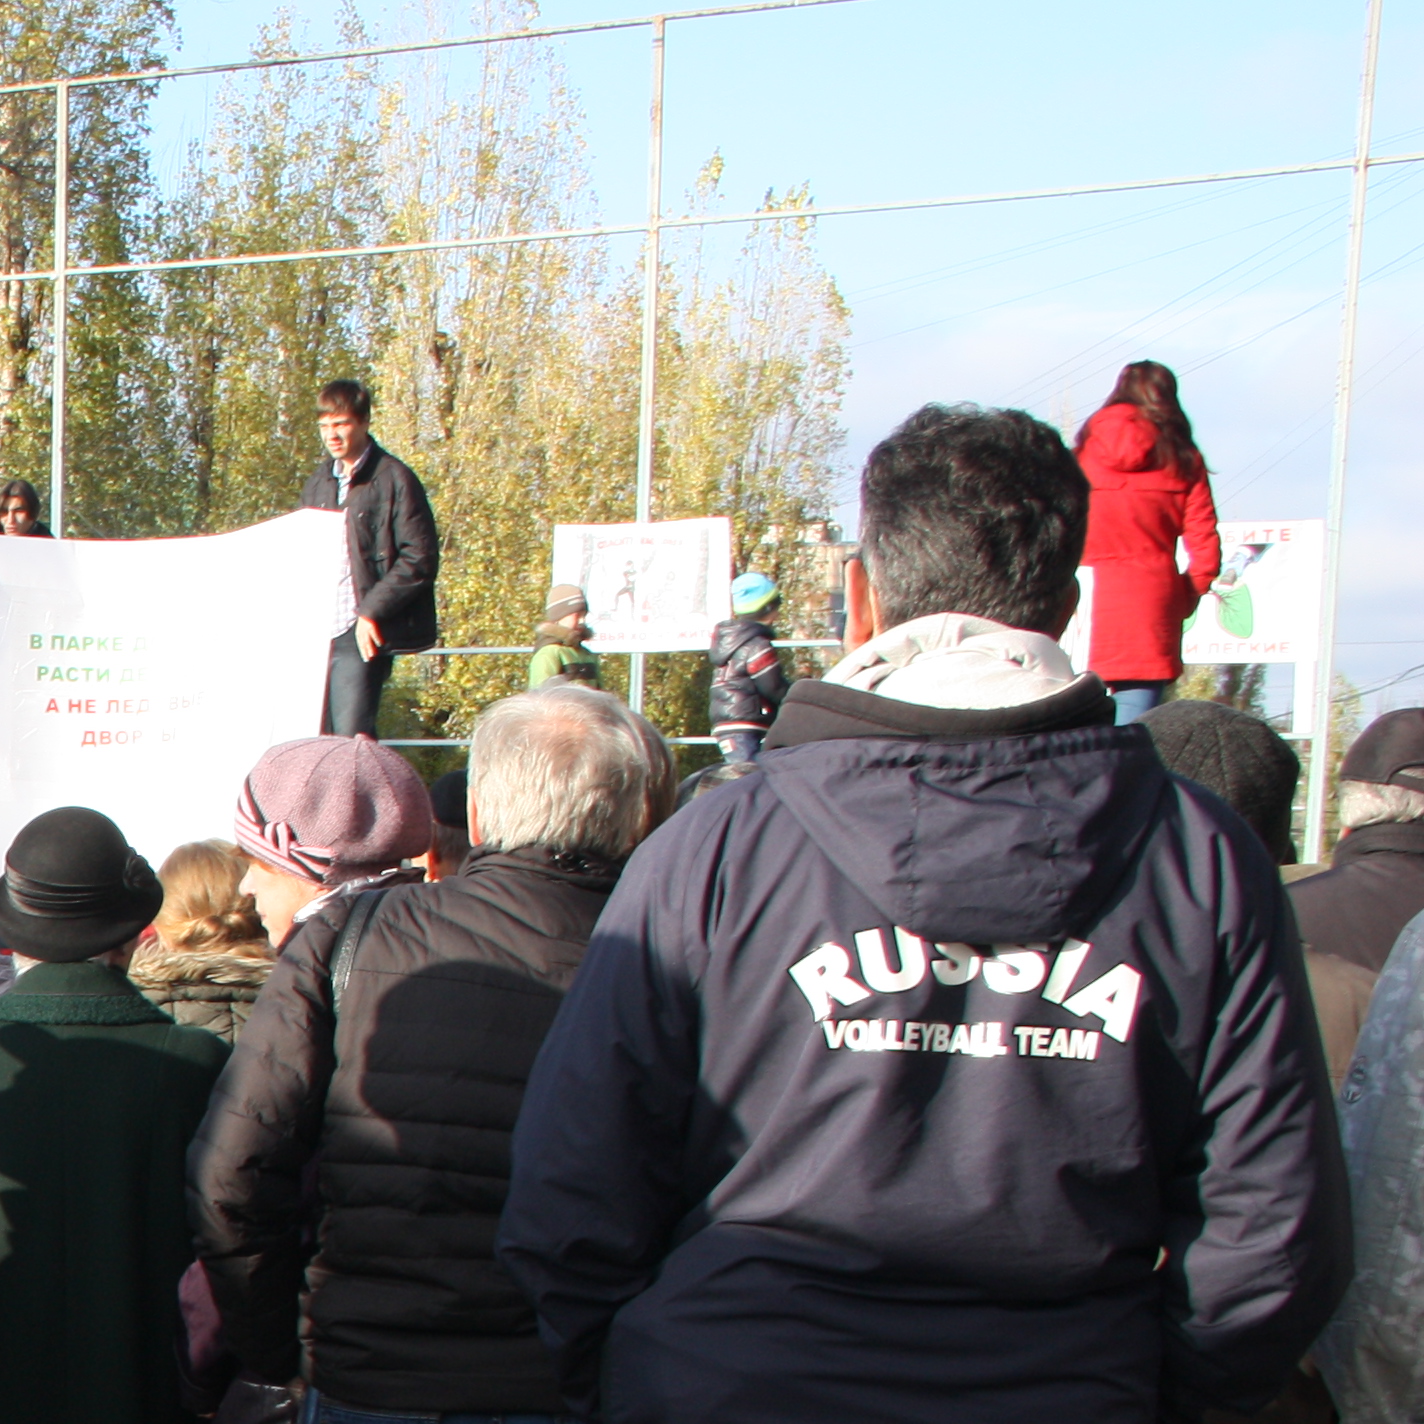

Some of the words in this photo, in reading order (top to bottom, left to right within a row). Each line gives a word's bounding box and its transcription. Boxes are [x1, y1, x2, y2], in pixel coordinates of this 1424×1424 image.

[1224, 528, 1291, 543] БИТЕ
[29, 633, 43, 650] В
[49, 634, 124, 652] ПАРКЕ
[36, 665, 111, 683] РАСТИ
[45, 698, 60, 713] А
[66, 698, 97, 714] НЕ
[81, 729, 176, 747] ДВОРЫ
[788, 926, 1143, 1043] RUSSIA
[821, 1018, 1010, 1058] VOLLEYBALL
[1012, 1024, 1102, 1061] TEAM
